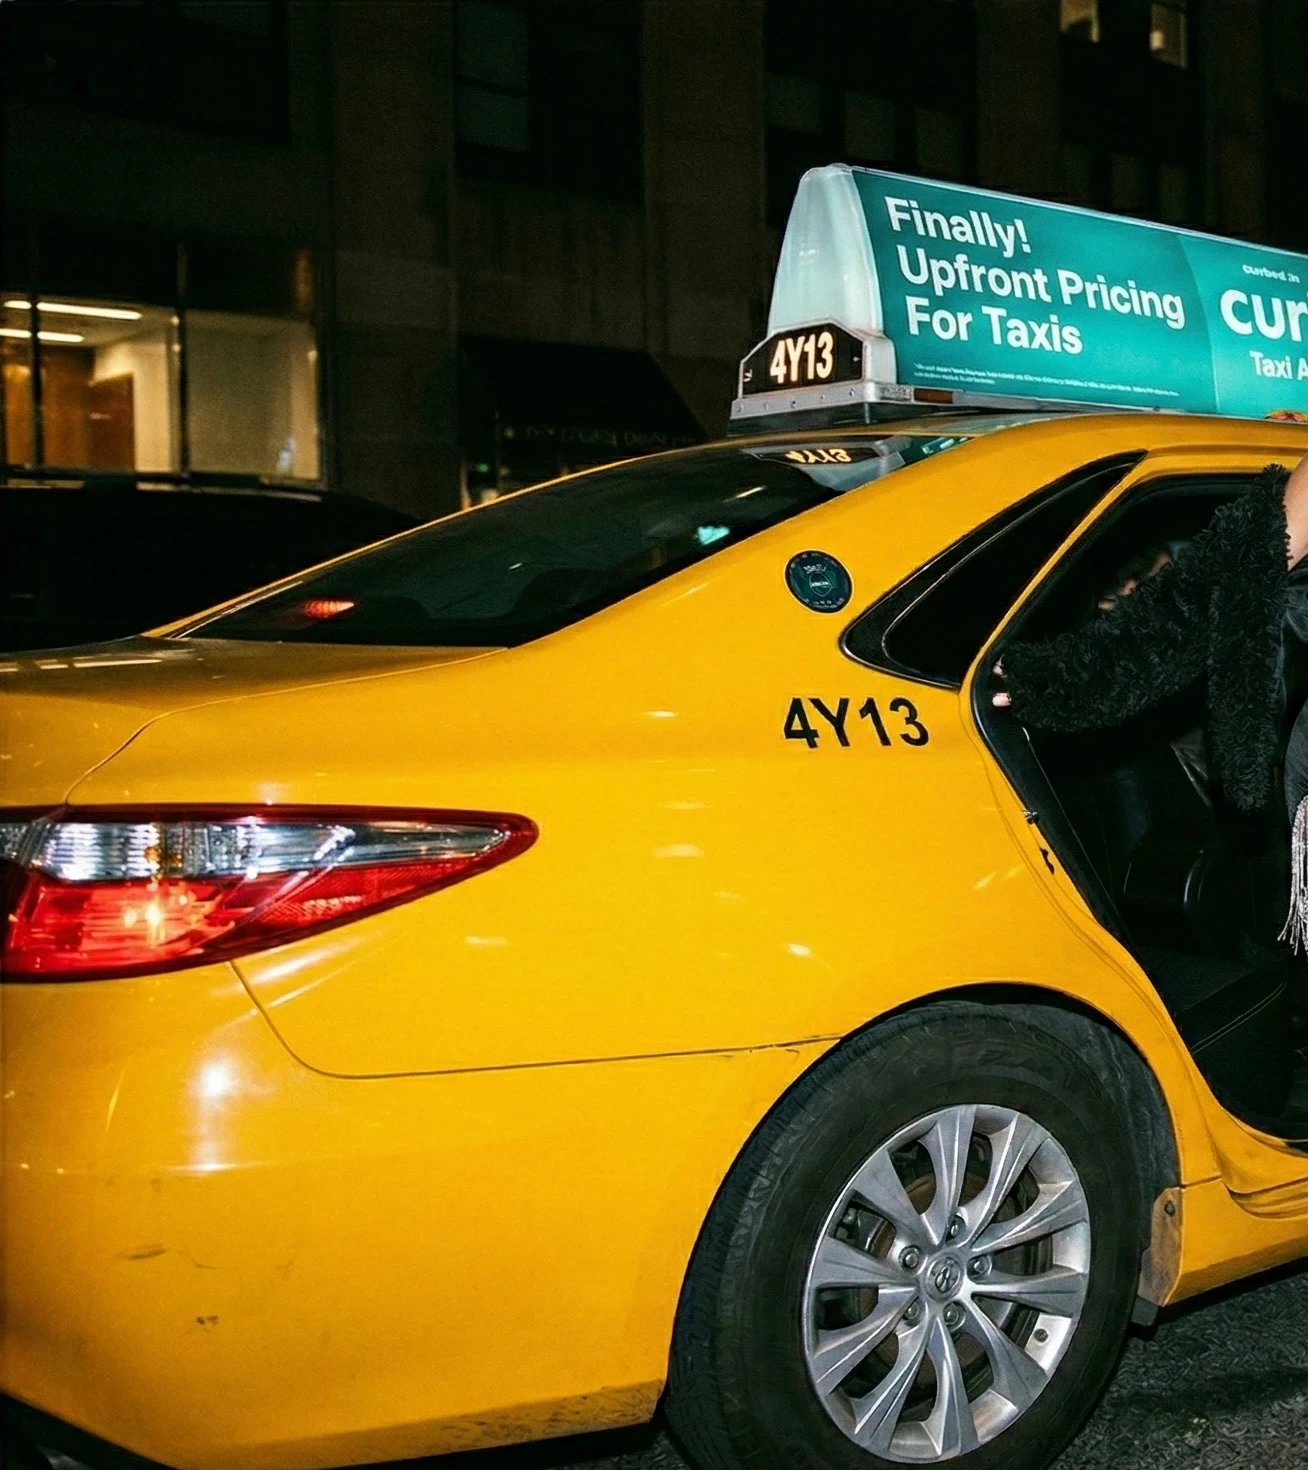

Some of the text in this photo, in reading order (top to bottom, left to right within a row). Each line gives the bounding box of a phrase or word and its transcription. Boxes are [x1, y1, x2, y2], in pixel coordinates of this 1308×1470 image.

[884, 196, 1032, 258] Finally!
[896, 244, 1186, 330] Upfront Pricing
[905, 295, 1084, 355] For Taxis
[769, 331, 834, 384] 4Y13
[1249, 350, 1293, 380] Taxi
[783, 697, 930, 749] 4Y13
